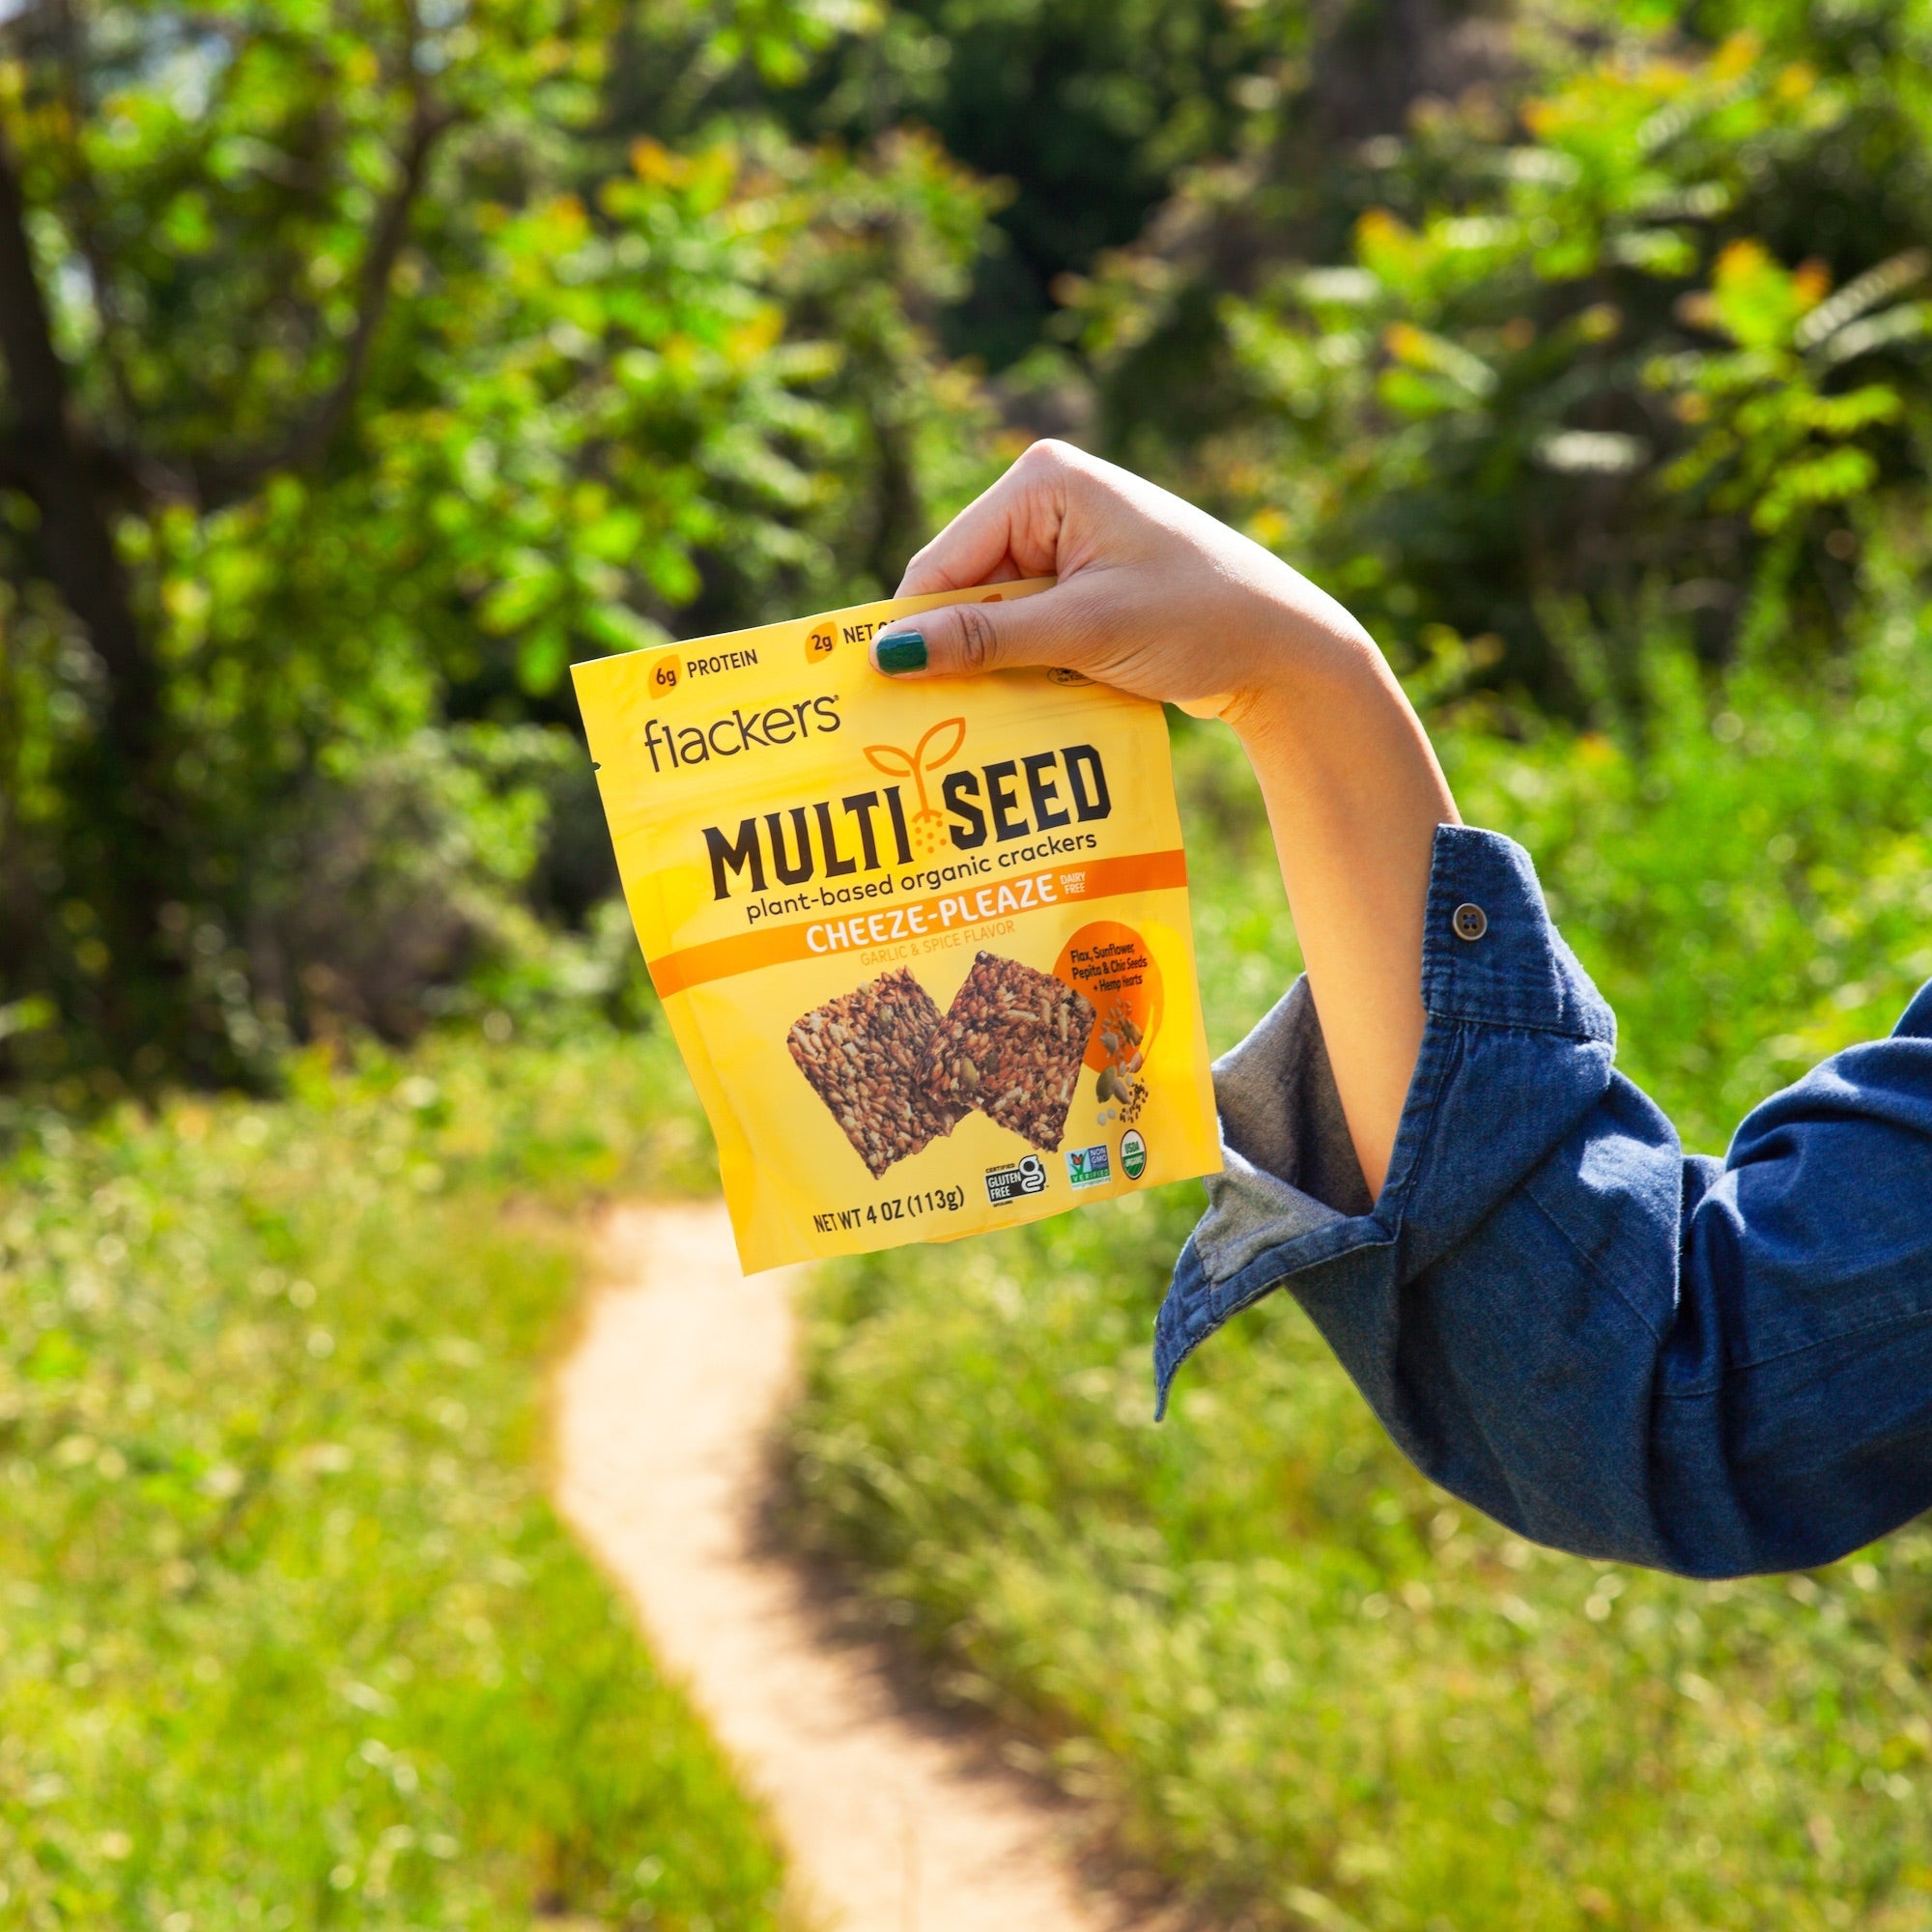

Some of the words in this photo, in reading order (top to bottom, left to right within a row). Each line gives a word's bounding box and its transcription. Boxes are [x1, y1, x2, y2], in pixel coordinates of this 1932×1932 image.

[811, 635, 833, 652] 2g
[842, 623, 873, 644] NET
[656, 668, 677, 687] 6g
[687, 649, 758, 678] PROTEIN
[644, 696, 841, 773] flackers
[701, 785, 914, 901] MULTI
[942, 744, 1112, 851] SEED
[747, 873, 894, 924] plant-based
[900, 855, 993, 891] organic
[998, 835, 1097, 867] crackers
[1060, 871, 1086, 885] DAIRY
[1065, 882, 1086, 895] FREE
[806, 873, 1058, 952] CHEEZE-PLEAZE
[860, 945, 908, 966] GARLIC
[911, 944, 919, 956] &
[923, 933, 960, 954] SPICE
[965, 921, 1015, 943] FLAVOR
[1070, 949, 1094, 963] Flax,
[1071, 965, 1102, 980] Pepita
[1102, 961, 1110, 974] &
[1110, 959, 1126, 973] Chia
[1127, 954, 1148, 971] Seeds
[1098, 979, 1121, 992] Hemp
[1122, 974, 1143, 987] Hearts
[1090, 1147, 1106, 1156] NON
[1092, 1154, 1107, 1164] GMO
[988, 1172, 1022, 1188] GLUTEN
[1072, 1170, 1110, 1182] VERIFIED
[990, 1186, 1011, 1200] FREE
[812, 1213, 838, 1233] NET
[838, 1208, 862, 1230] WT
[867, 1206, 877, 1224] 4
[881, 1199, 904, 1221] OZ
[907, 1185, 964, 1217] (113g)
